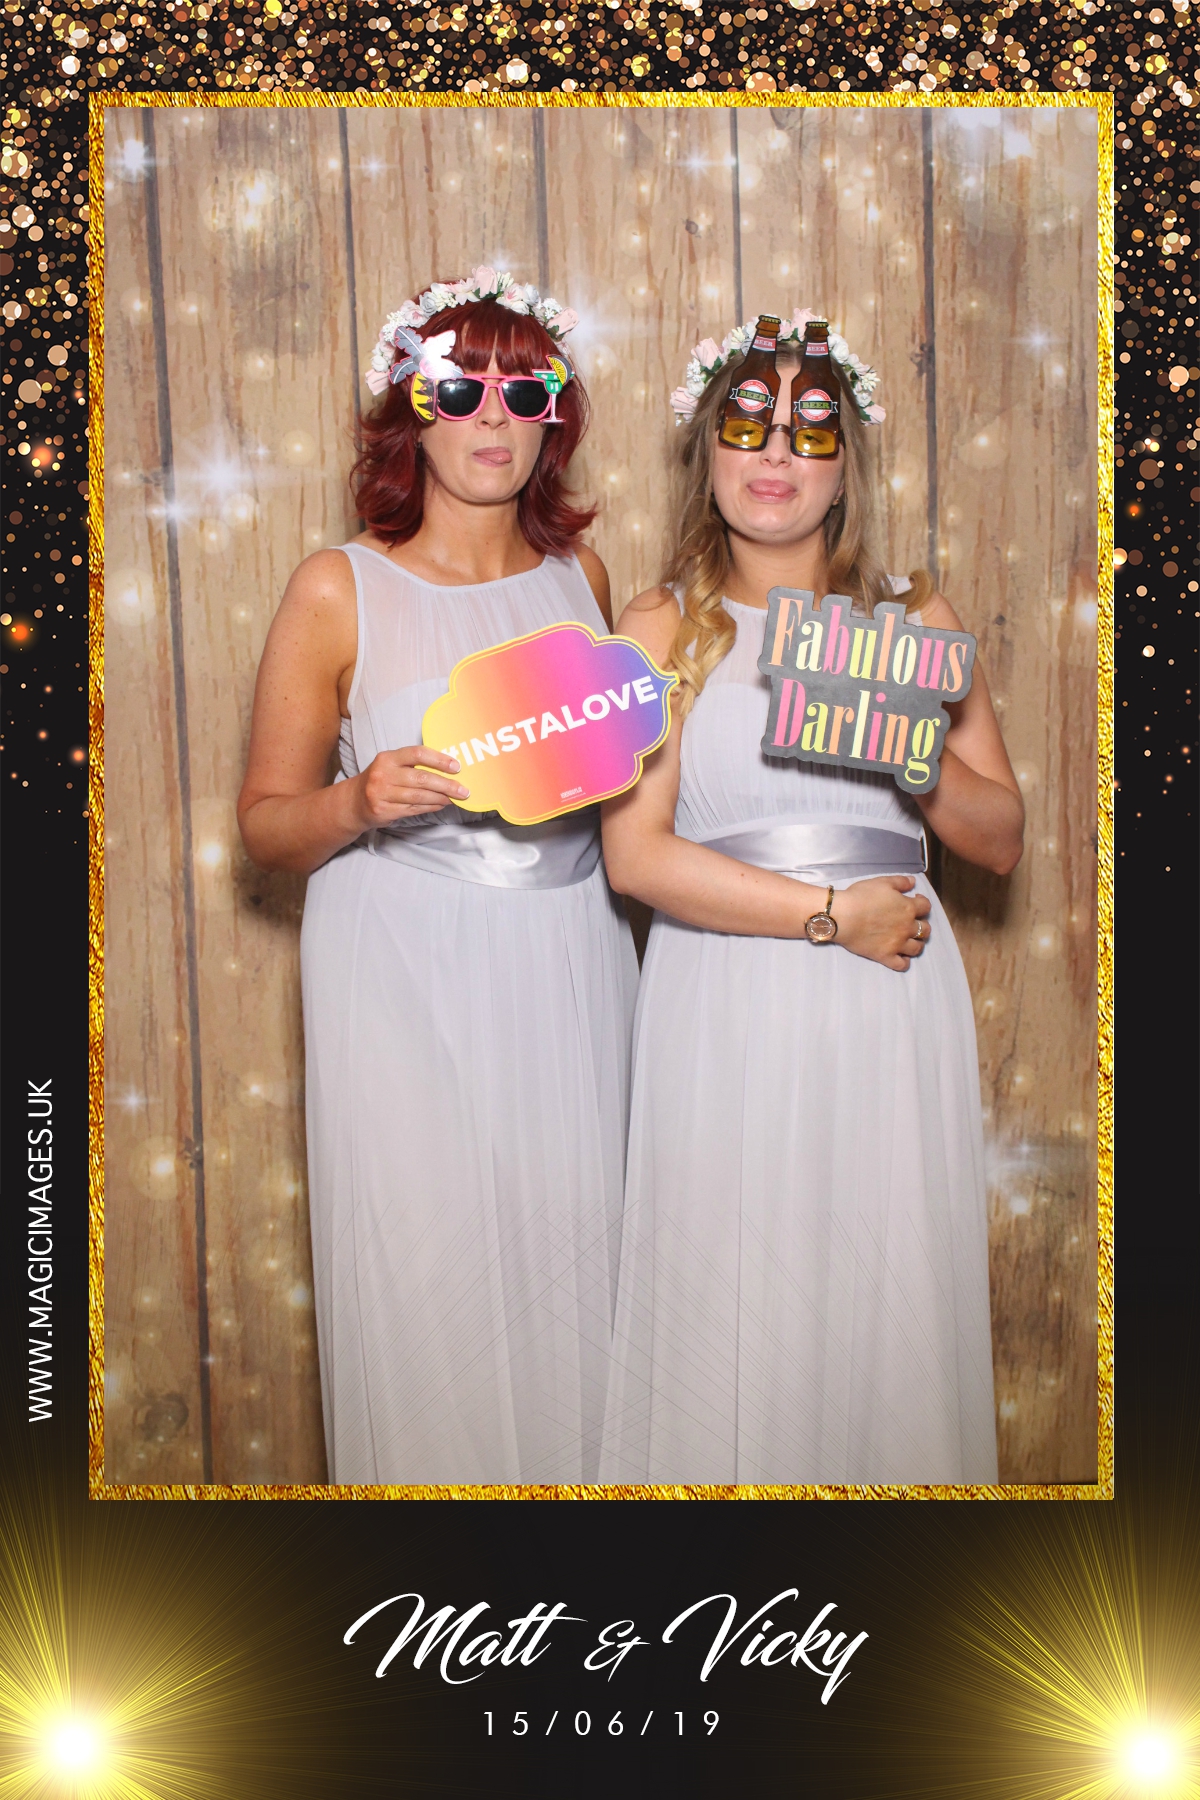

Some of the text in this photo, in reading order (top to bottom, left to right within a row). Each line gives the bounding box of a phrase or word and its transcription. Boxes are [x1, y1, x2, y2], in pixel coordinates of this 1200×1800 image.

[754, 339, 773, 347] BEER
[738, 390, 767, 403] BEER
[802, 401, 830, 409] BEER
[767, 596, 968, 693] Fabulous
[770, 677, 941, 785] Darling
